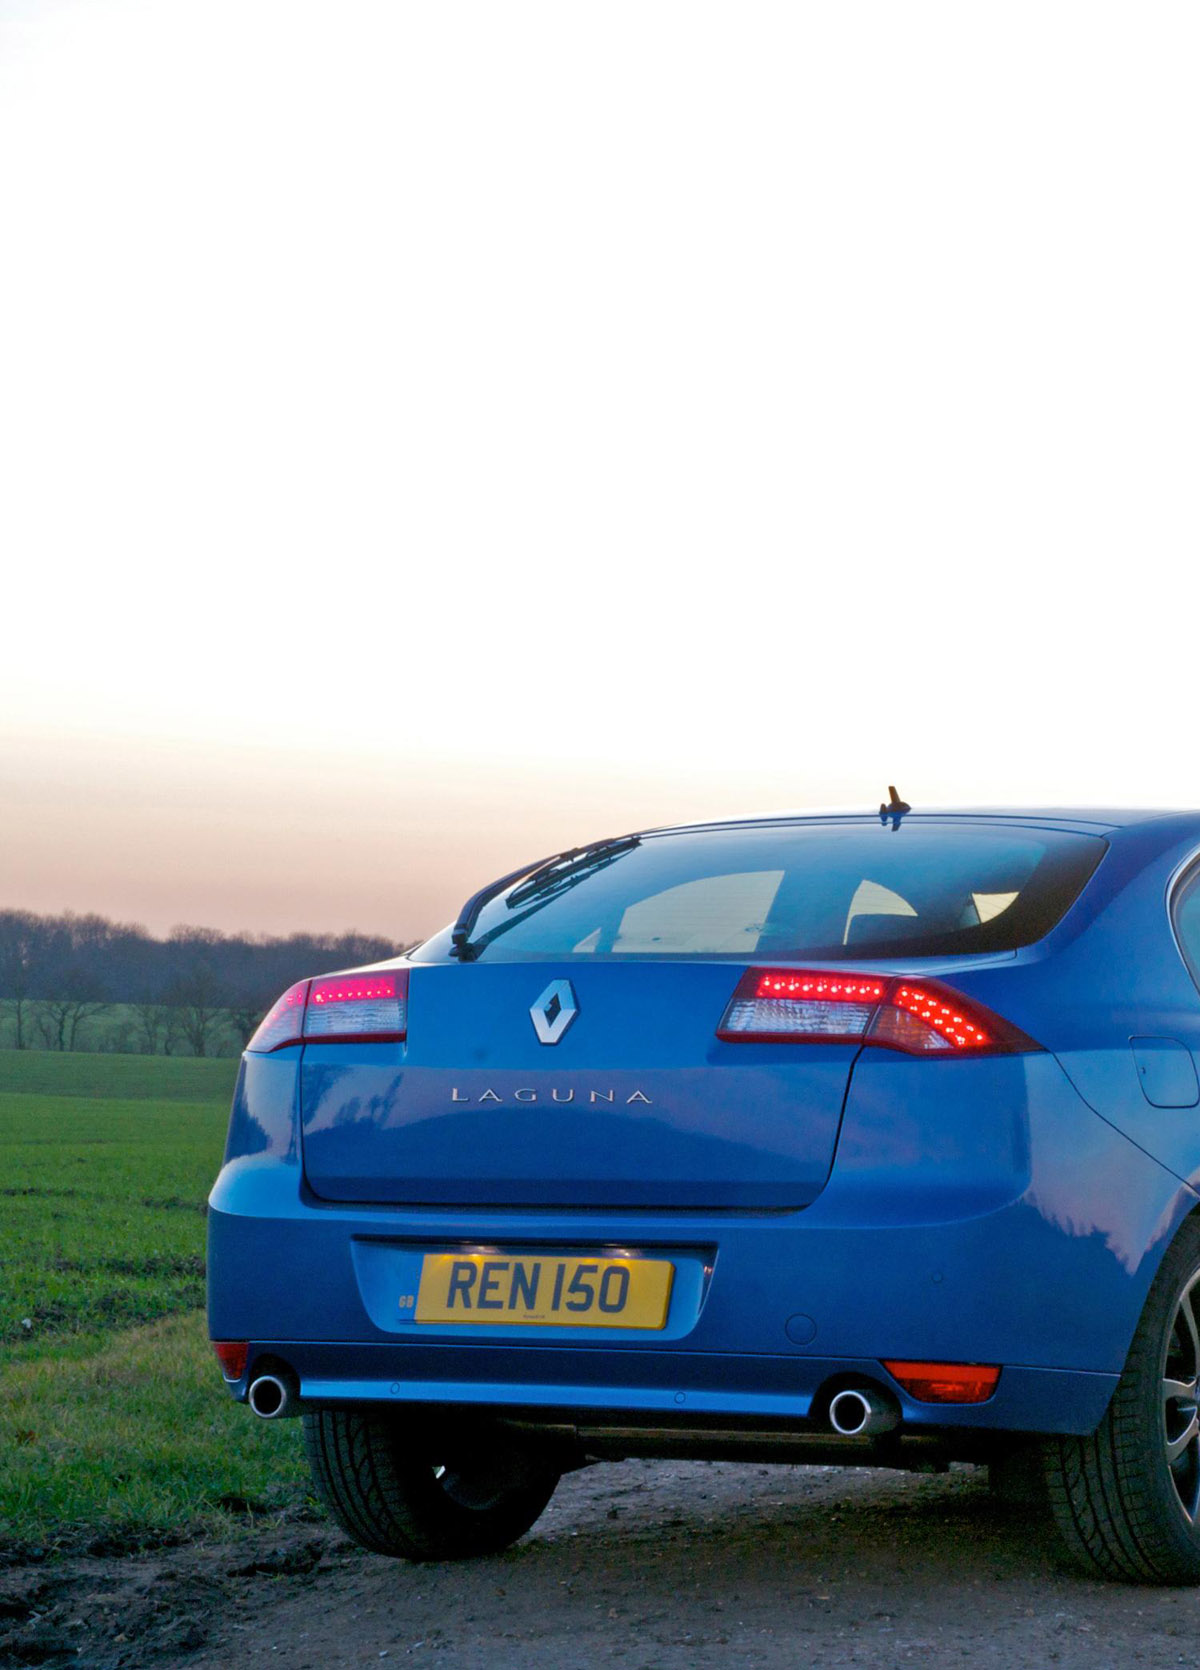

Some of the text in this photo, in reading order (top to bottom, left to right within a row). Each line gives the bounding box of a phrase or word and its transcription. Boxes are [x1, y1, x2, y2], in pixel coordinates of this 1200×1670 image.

[452, 1087, 653, 1104] LAGUNA
[446, 1261, 631, 1313] REN 150
[399, 1295, 414, 1308] GB
